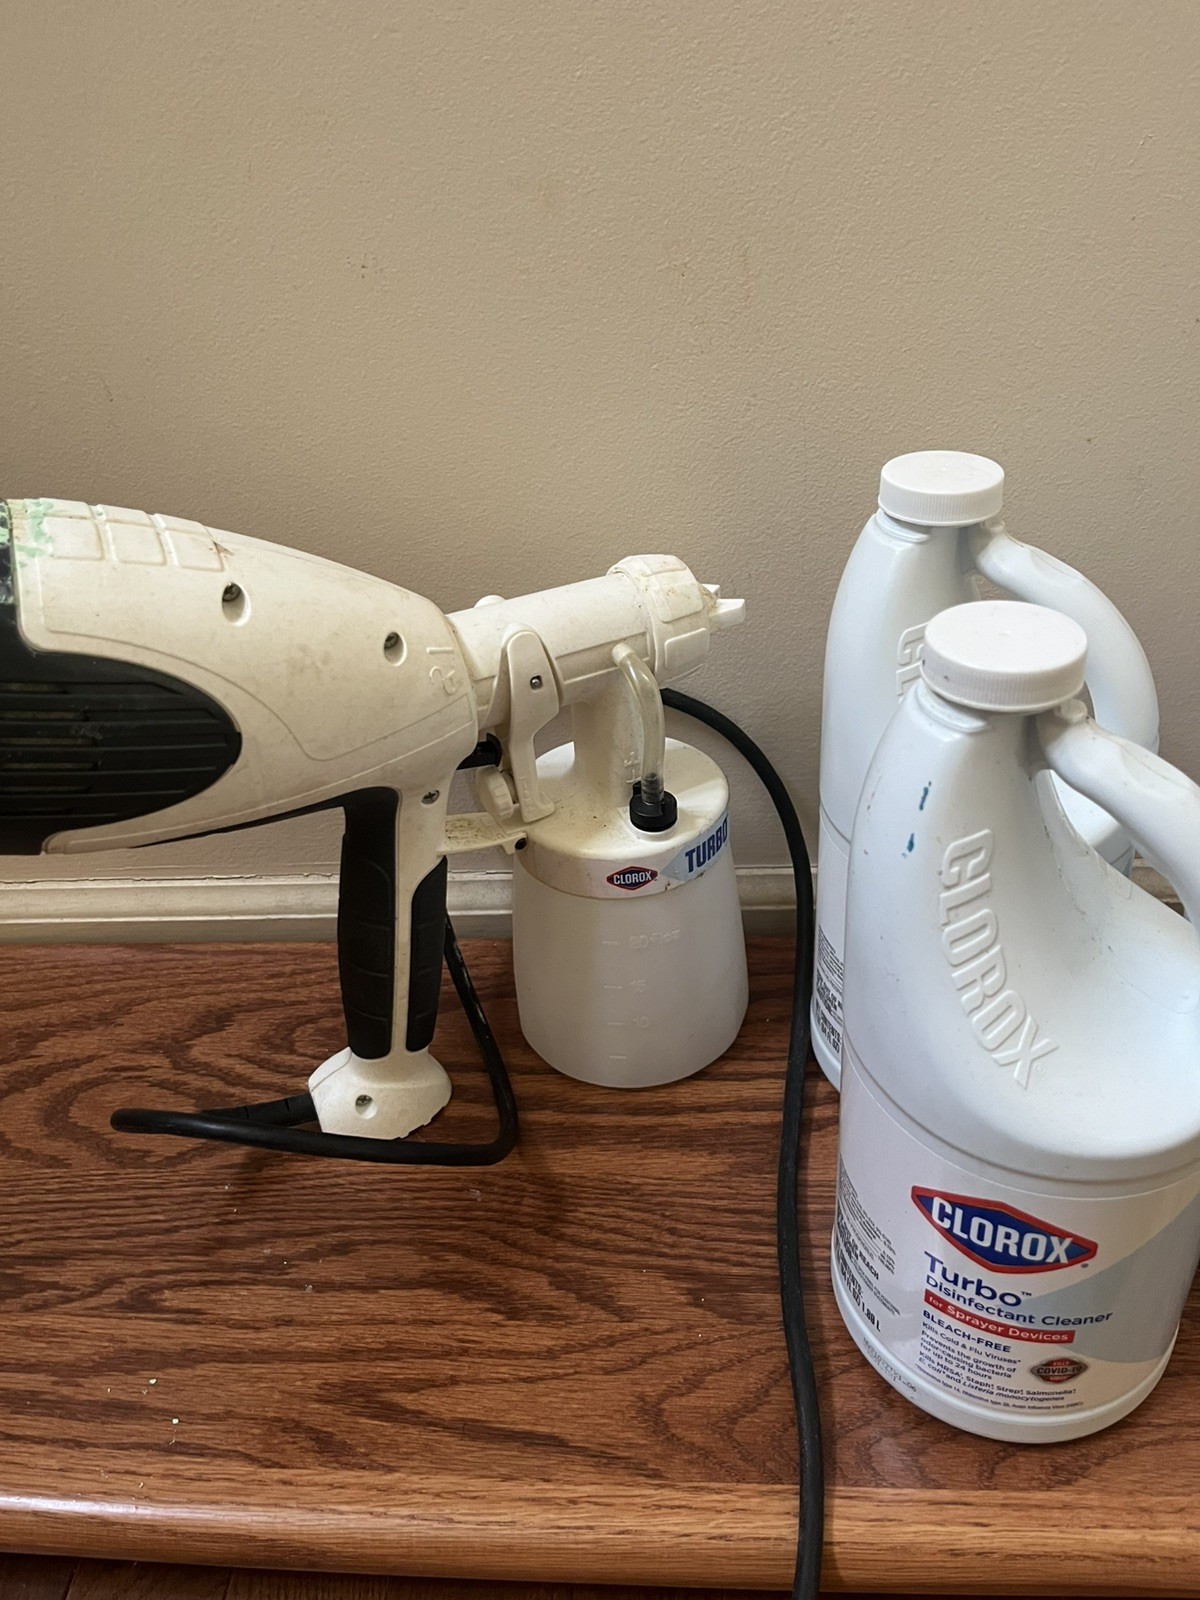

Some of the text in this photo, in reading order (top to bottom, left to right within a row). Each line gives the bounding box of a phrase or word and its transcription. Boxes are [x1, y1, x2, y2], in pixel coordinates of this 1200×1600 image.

[685, 816, 728, 873] TURBO
[613, 870, 652, 885] CLOROX
[938, 828, 1060, 1091] CLOROX
[931, 1196, 1073, 1264] CLOROX
[926, 1274, 1036, 1324] Disinfectant
[1041, 1312, 1114, 1326] Cleaner
[928, 1296, 1069, 1340] for Sprayer Devices
[921, 1330, 956, 1353] Prevents
[957, 1350, 972, 1361] the
[972, 1357, 1005, 1371] growth
[922, 1309, 1012, 1353] BLEACH-FREE
[922, 1321, 938, 1335] Kills
[940, 1331, 959, 1346] Cold
[969, 1346, 983, 1356] Flu
[919, 1351, 936, 1364] Kills
[920, 1336, 974, 1368] odor-causing
[975, 1363, 1012, 1379] bacteria
[920, 1342, 992, 1380] for up to 24 hours
[1036, 1365, 1083, 1375] COVID-19
[945, 1372, 961, 1384] and
[962, 1381, 994, 1395] Listeria
